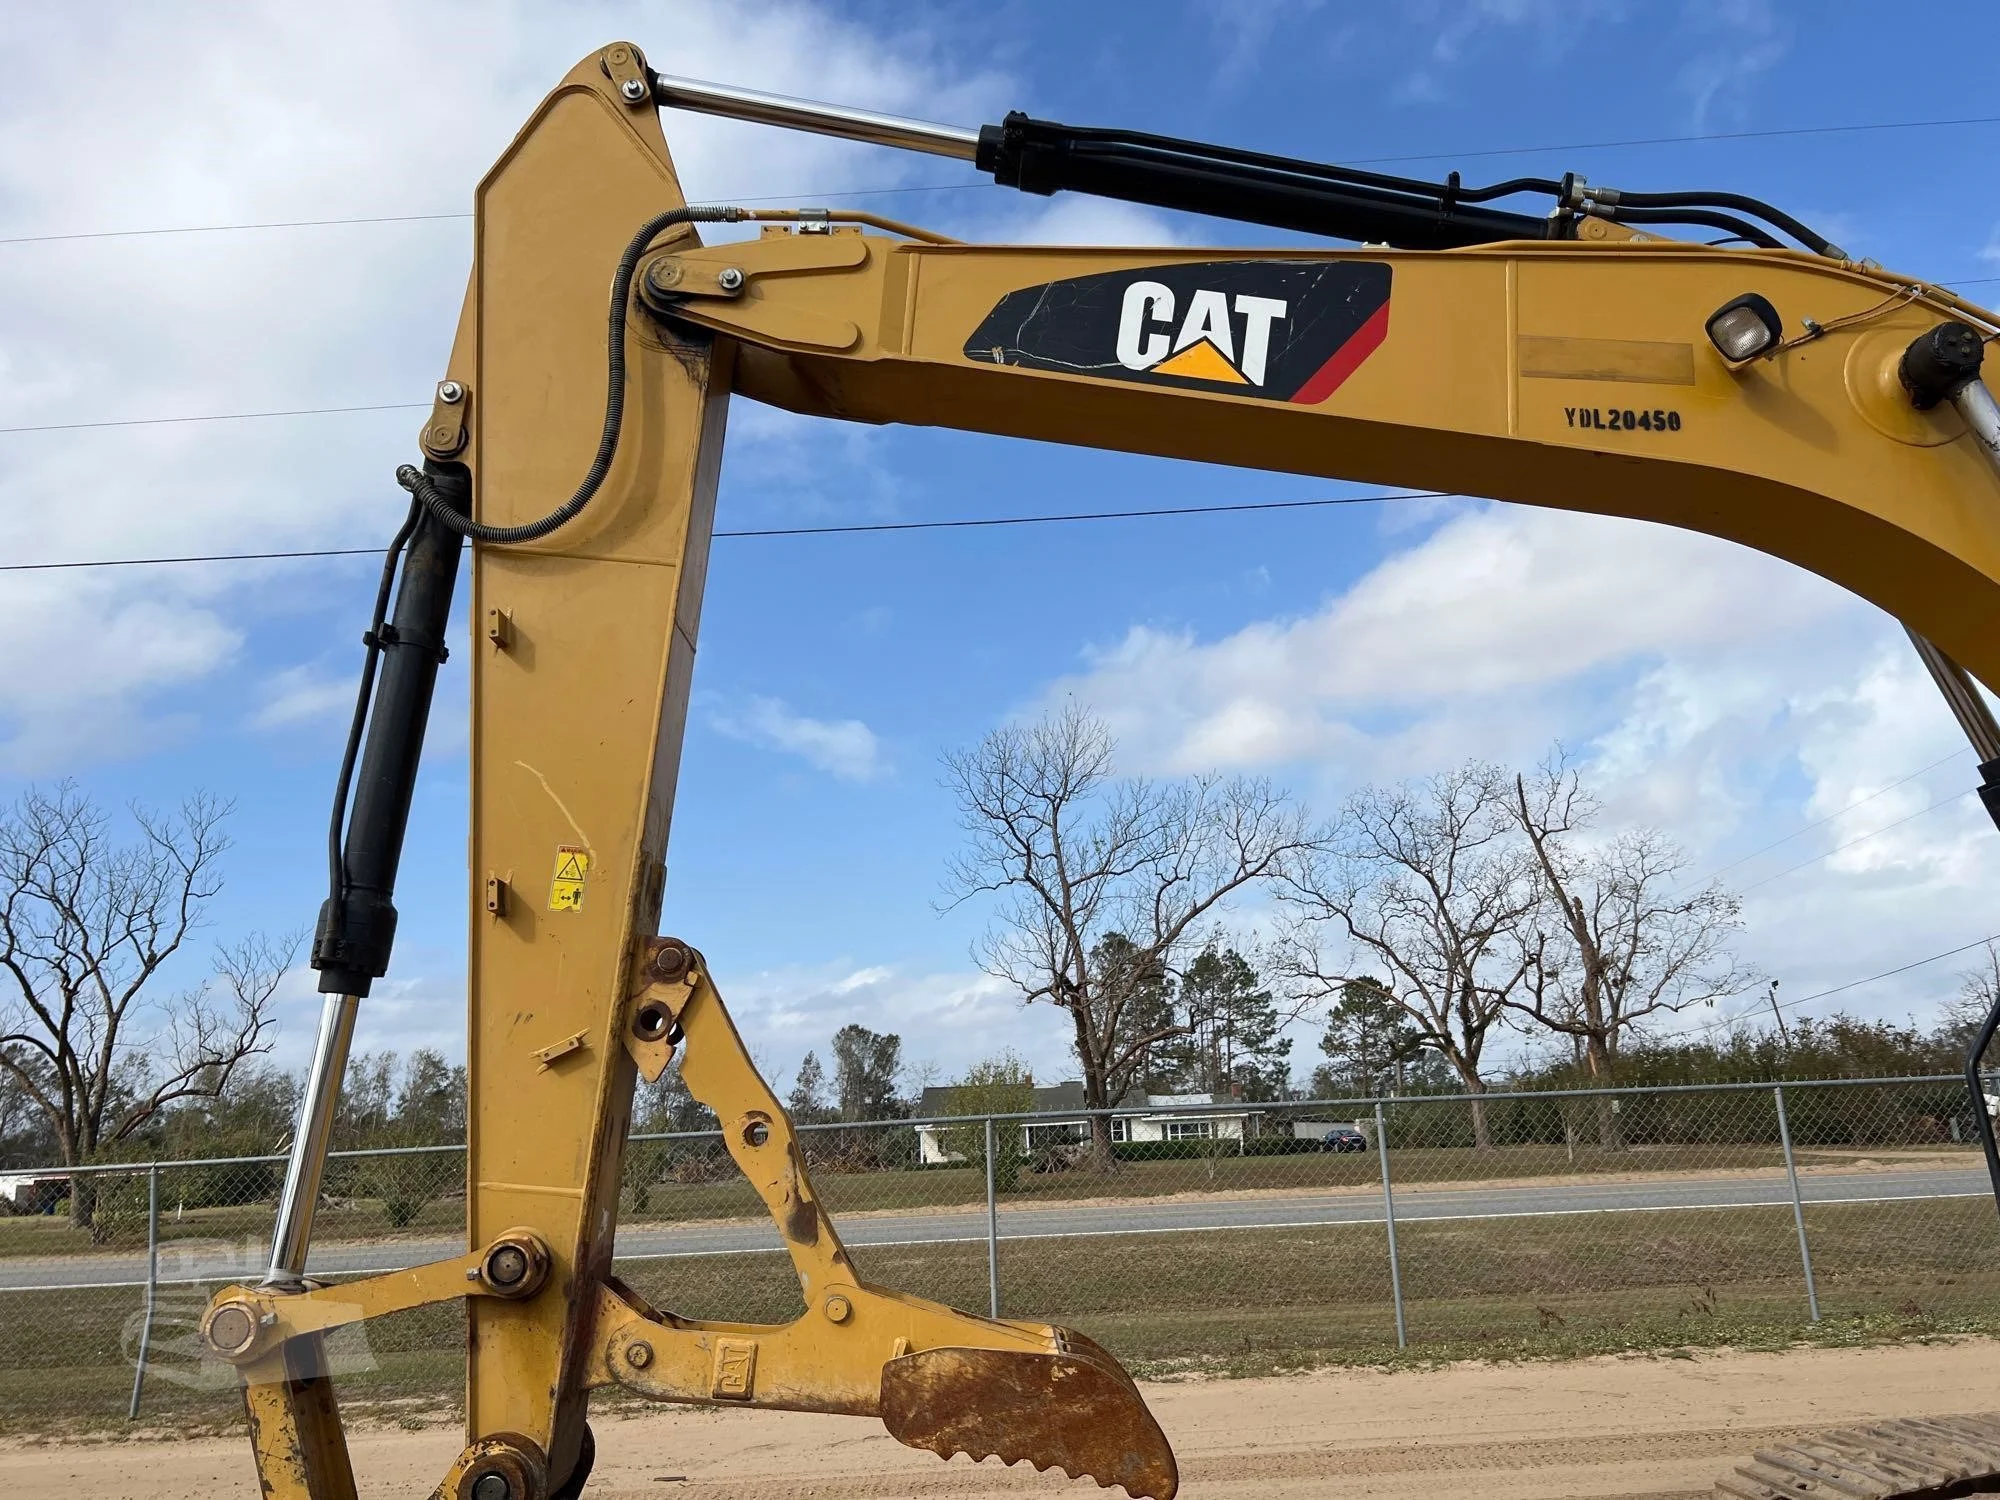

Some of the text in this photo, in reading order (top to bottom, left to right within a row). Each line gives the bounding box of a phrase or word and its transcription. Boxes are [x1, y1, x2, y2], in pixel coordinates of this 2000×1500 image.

[1116, 281, 1287, 387] CAT
[1564, 407, 1681, 431] YDL20450
[720, 1346, 749, 1392] CAT
